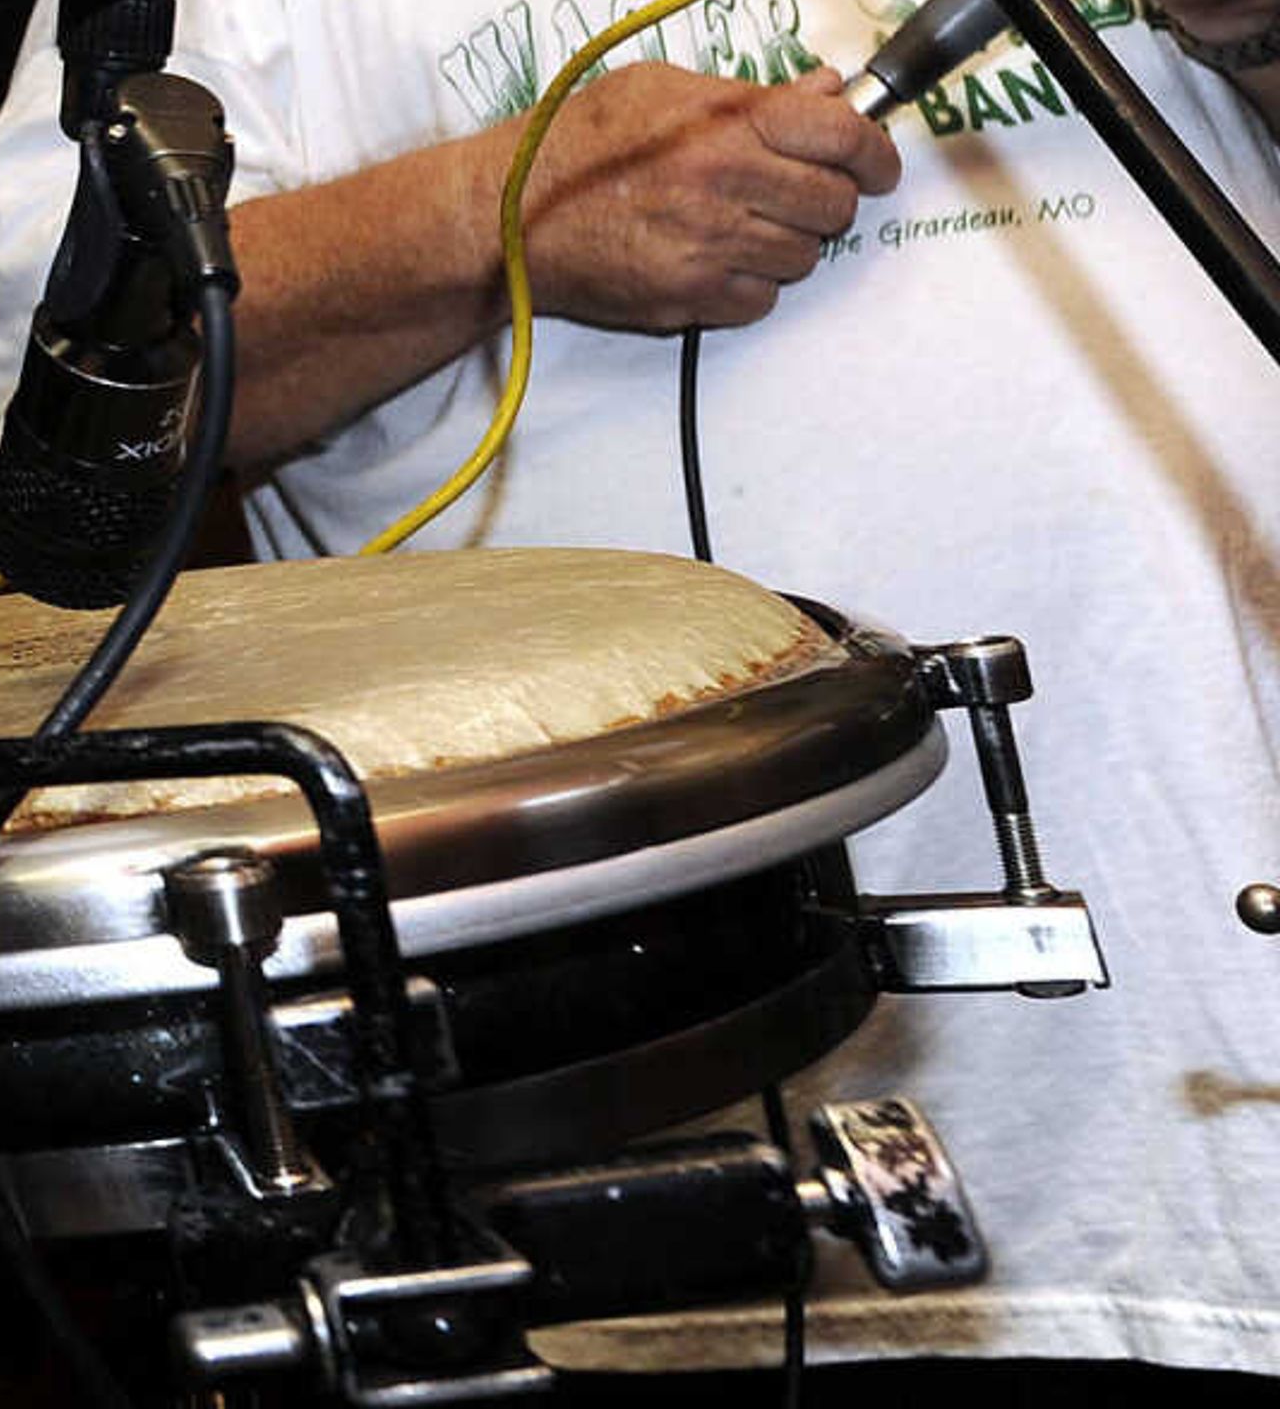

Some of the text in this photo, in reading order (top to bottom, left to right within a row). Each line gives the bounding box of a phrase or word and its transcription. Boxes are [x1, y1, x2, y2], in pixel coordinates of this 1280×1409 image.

[915, 61, 1068, 137] BAN
[818, 193, 1095, 262] ape Girardeau, MO
